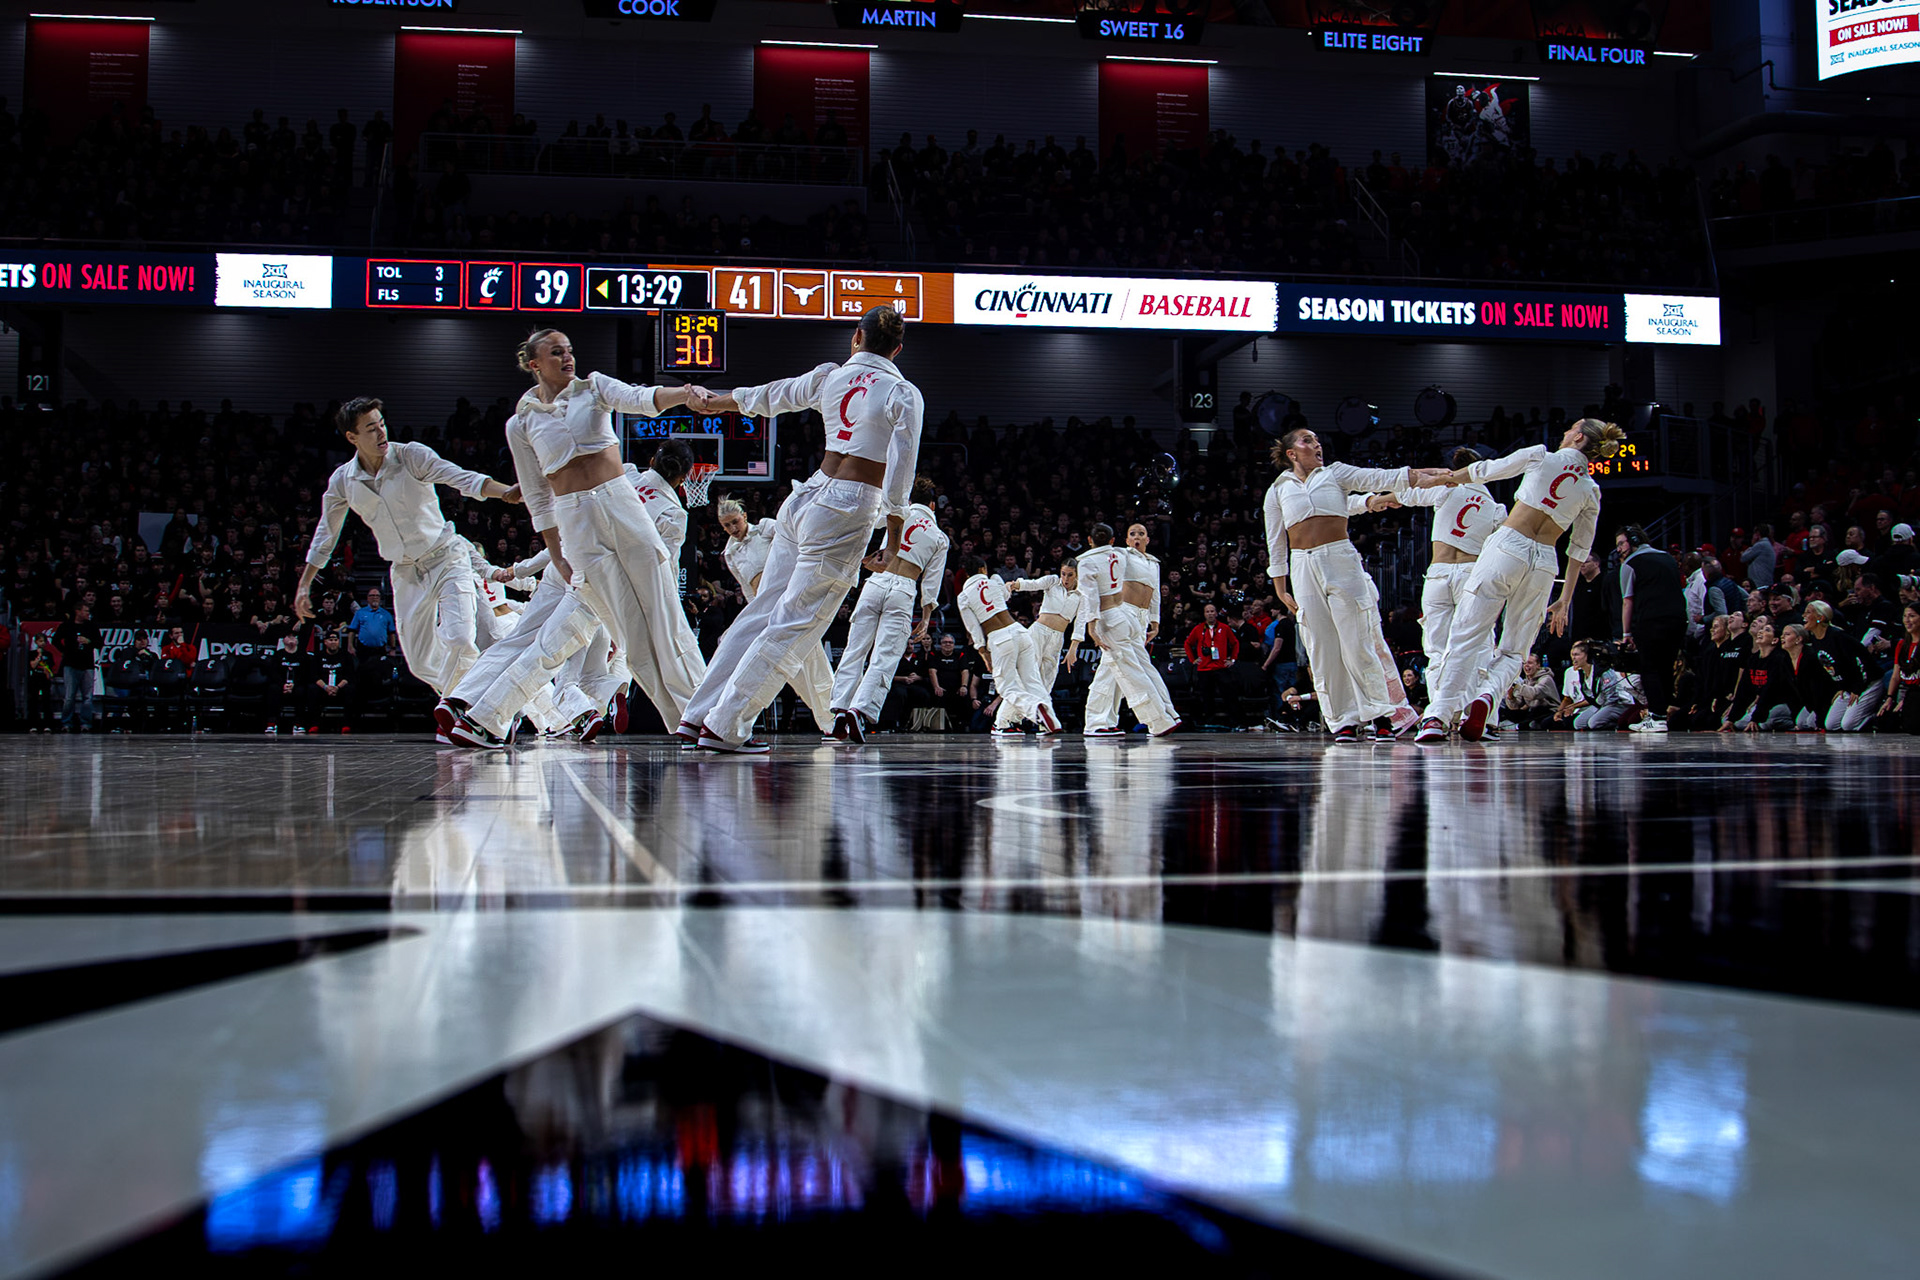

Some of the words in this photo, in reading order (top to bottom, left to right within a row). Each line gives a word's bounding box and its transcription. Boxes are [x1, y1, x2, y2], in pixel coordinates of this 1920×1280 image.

[618, 0, 680, 16] COOK
[861, 7, 937, 27] MARTIN
[1099, 19, 1160, 38] SWEET
[1163, 23, 1185, 40] 16
[1837, 27, 1852, 42] ON
[1853, 22, 1876, 38] SALE
[1877, 17, 1909, 34] NOW!
[1323, 30, 1368, 49] ELITE
[1371, 33, 1424, 53] EIGHT
[1547, 44, 1598, 62] FINAL
[1600, 47, 1646, 65] FOUR
[1848, 45, 1888, 58] INAUGURAL
[42, 263, 71, 289] ON
[81, 264, 129, 290] SALE
[138, 265, 195, 292] NOW!
[376, 266, 402, 279] TOL
[435, 266, 443, 281] 3
[243, 279, 305, 290] INAUGURAL
[534, 270, 569, 304] 39
[617, 274, 683, 305] 13:29
[729, 275, 761, 309] 41
[840, 278, 865, 291] TOL
[894, 278, 904, 294] 4
[252, 289, 296, 299] SEASON
[378, 289, 399, 301] FLS
[435, 287, 443, 302] 5
[975, 286, 1113, 314] CINCINNATI
[1138, 294, 1252, 317] BASEBALL
[841, 301, 863, 313] FLS
[1298, 297, 1385, 322] SEASON
[1390, 300, 1476, 325] TICKETS
[1480, 302, 1506, 326] ON
[1513, 303, 1555, 327] SALE
[1561, 304, 1609, 329] NOW!
[675, 315, 718, 333] 13:29
[1647, 318, 1699, 328] INAUGURAL
[1656, 326, 1692, 336] SEASON
[675, 334, 713, 365] 30
[26, 374, 50, 391] 121
[1631, 460, 1650, 472] 41
[210, 642, 253, 656] DMG
